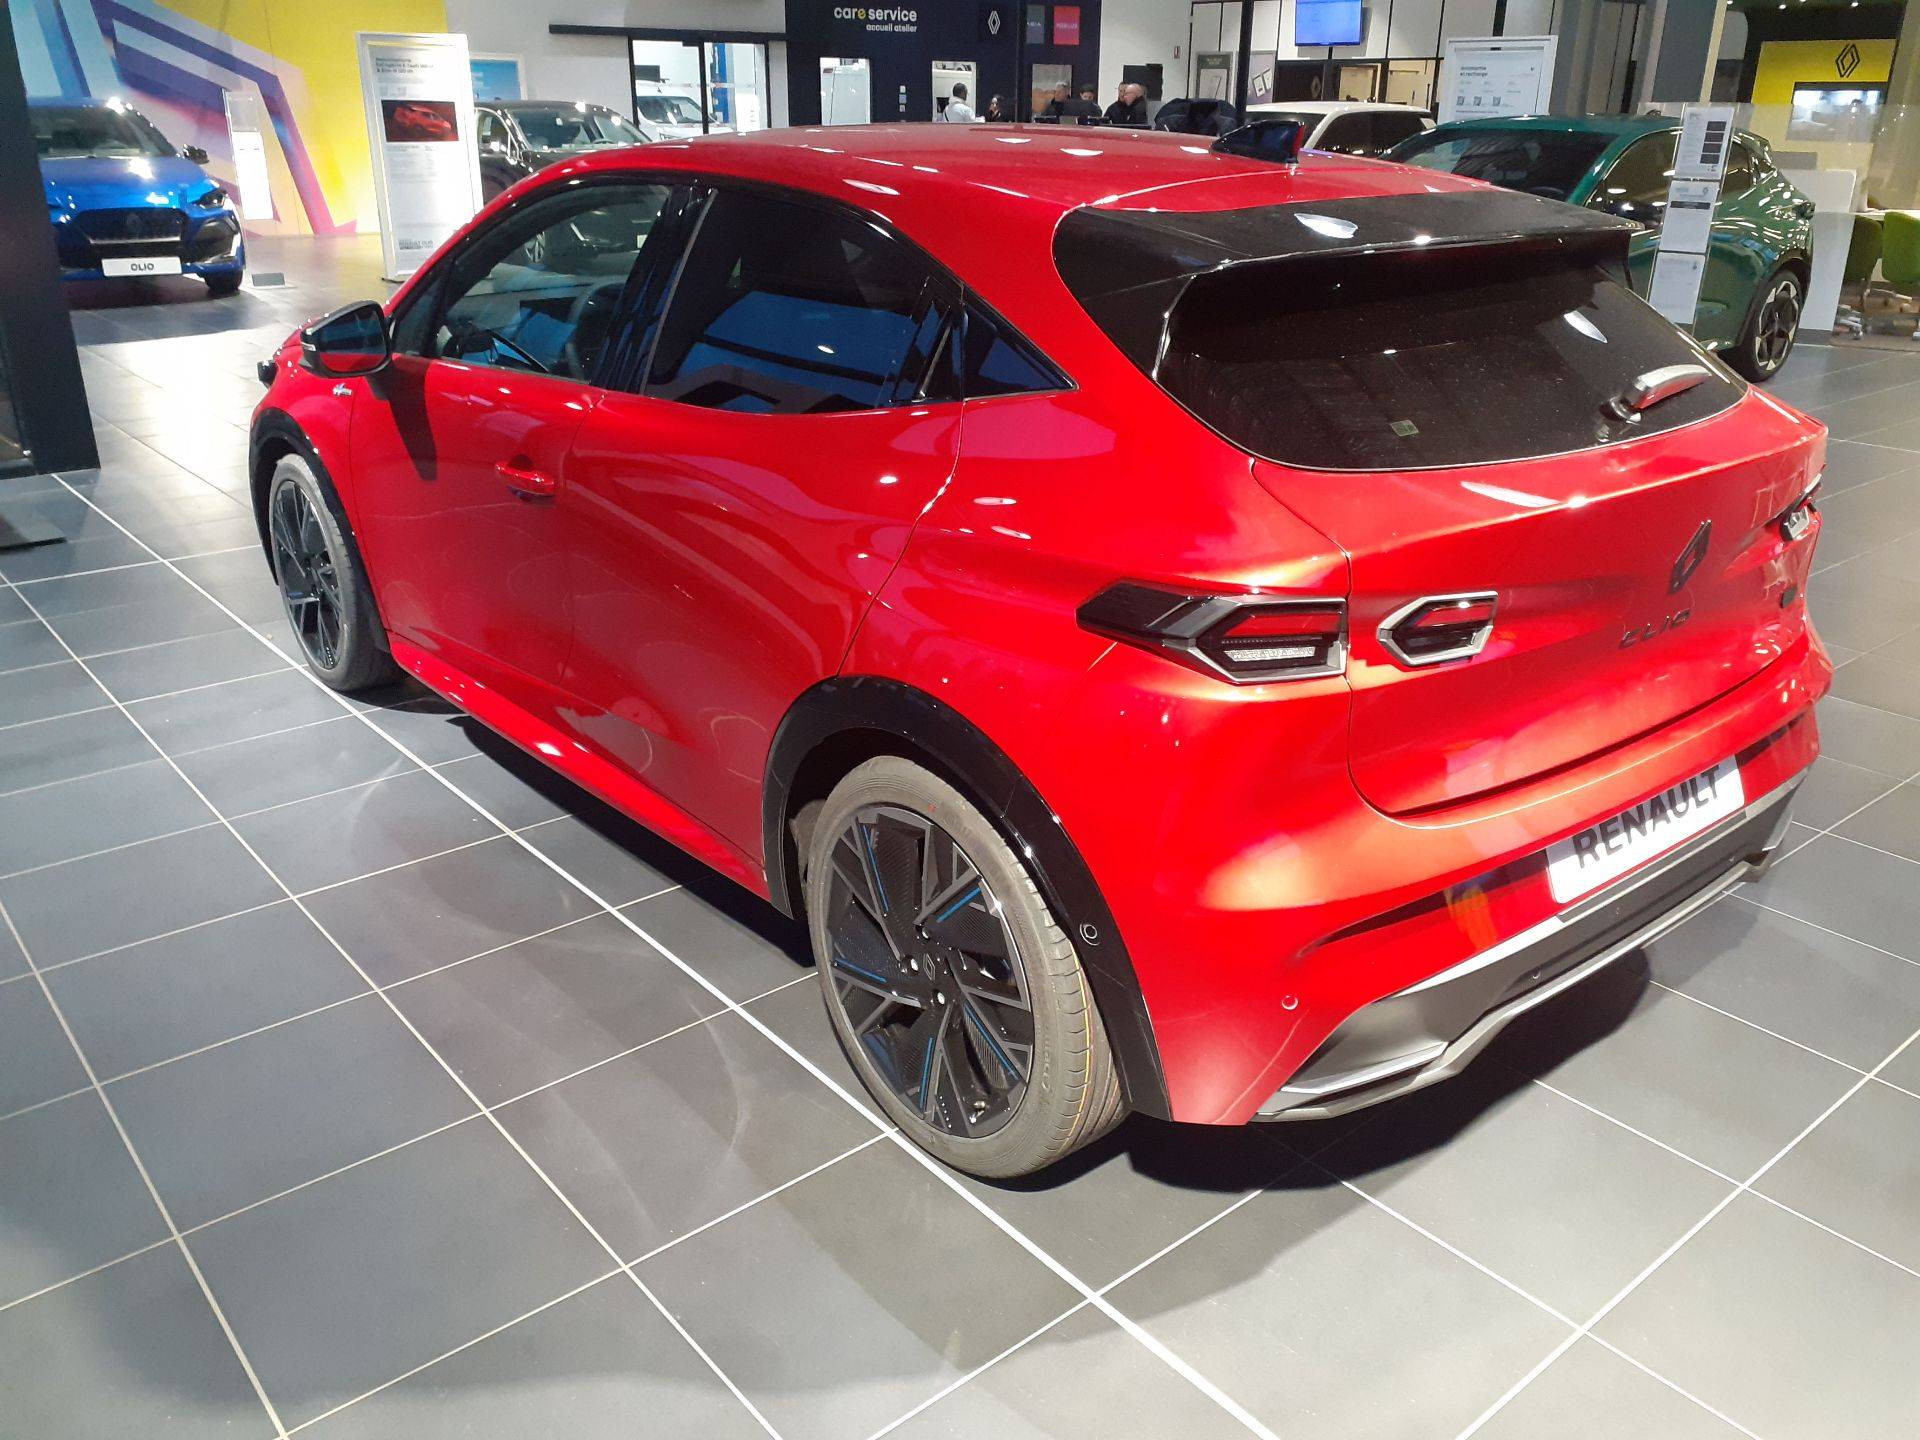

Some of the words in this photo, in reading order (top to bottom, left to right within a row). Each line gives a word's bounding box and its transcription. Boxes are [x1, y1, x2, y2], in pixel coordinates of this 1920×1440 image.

[833, 7, 866, 19] care
[868, 6, 917, 21] service
[866, 23, 892, 32] accueil
[894, 24, 917, 33] atelier
[1619, 607, 1691, 650] CLIO
[1571, 764, 1721, 869] RENAULT
